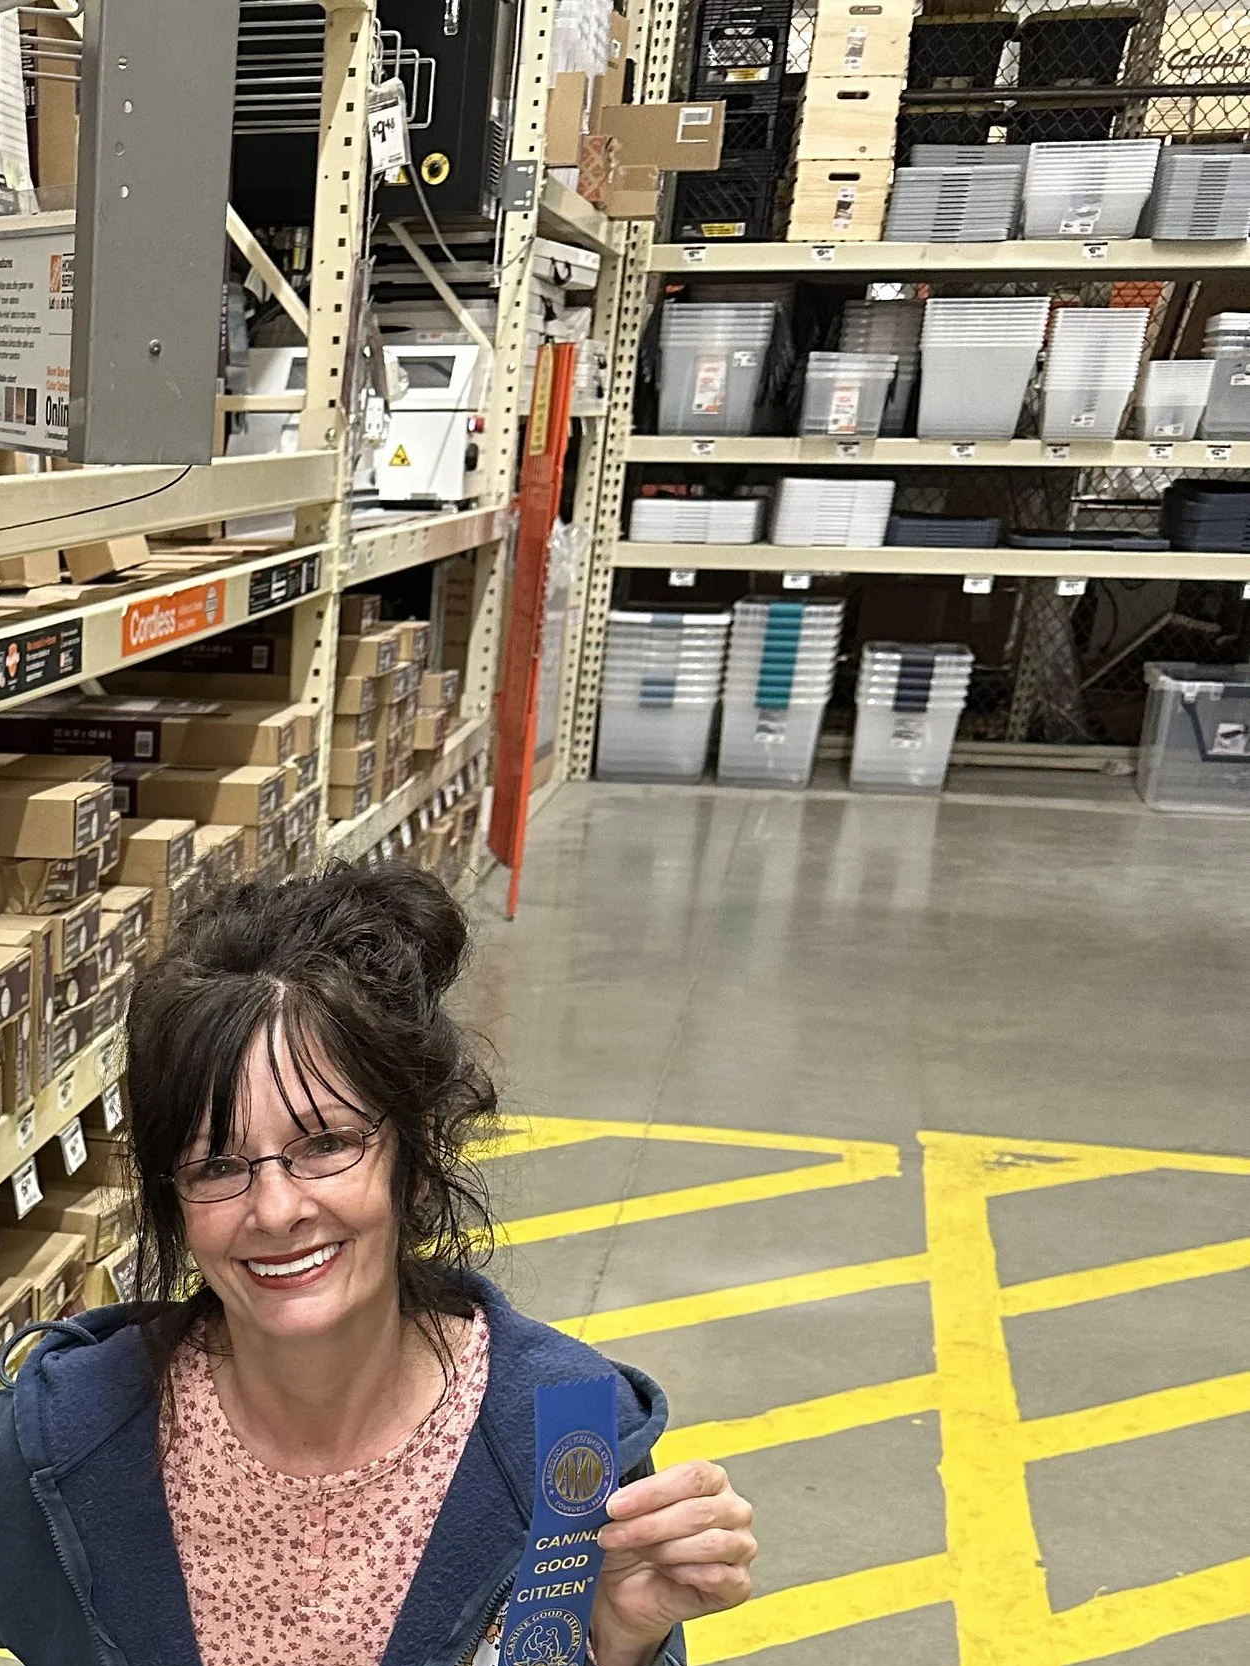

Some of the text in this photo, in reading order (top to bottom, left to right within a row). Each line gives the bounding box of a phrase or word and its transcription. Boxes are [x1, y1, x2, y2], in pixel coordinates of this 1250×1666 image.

[46, 396, 69, 427] Onlin
[130, 604, 176, 646] Cordless
[534, 1555, 589, 1574] GOOD
[506, 1610, 581, 1656] CANINE GOOD CITIZEN
